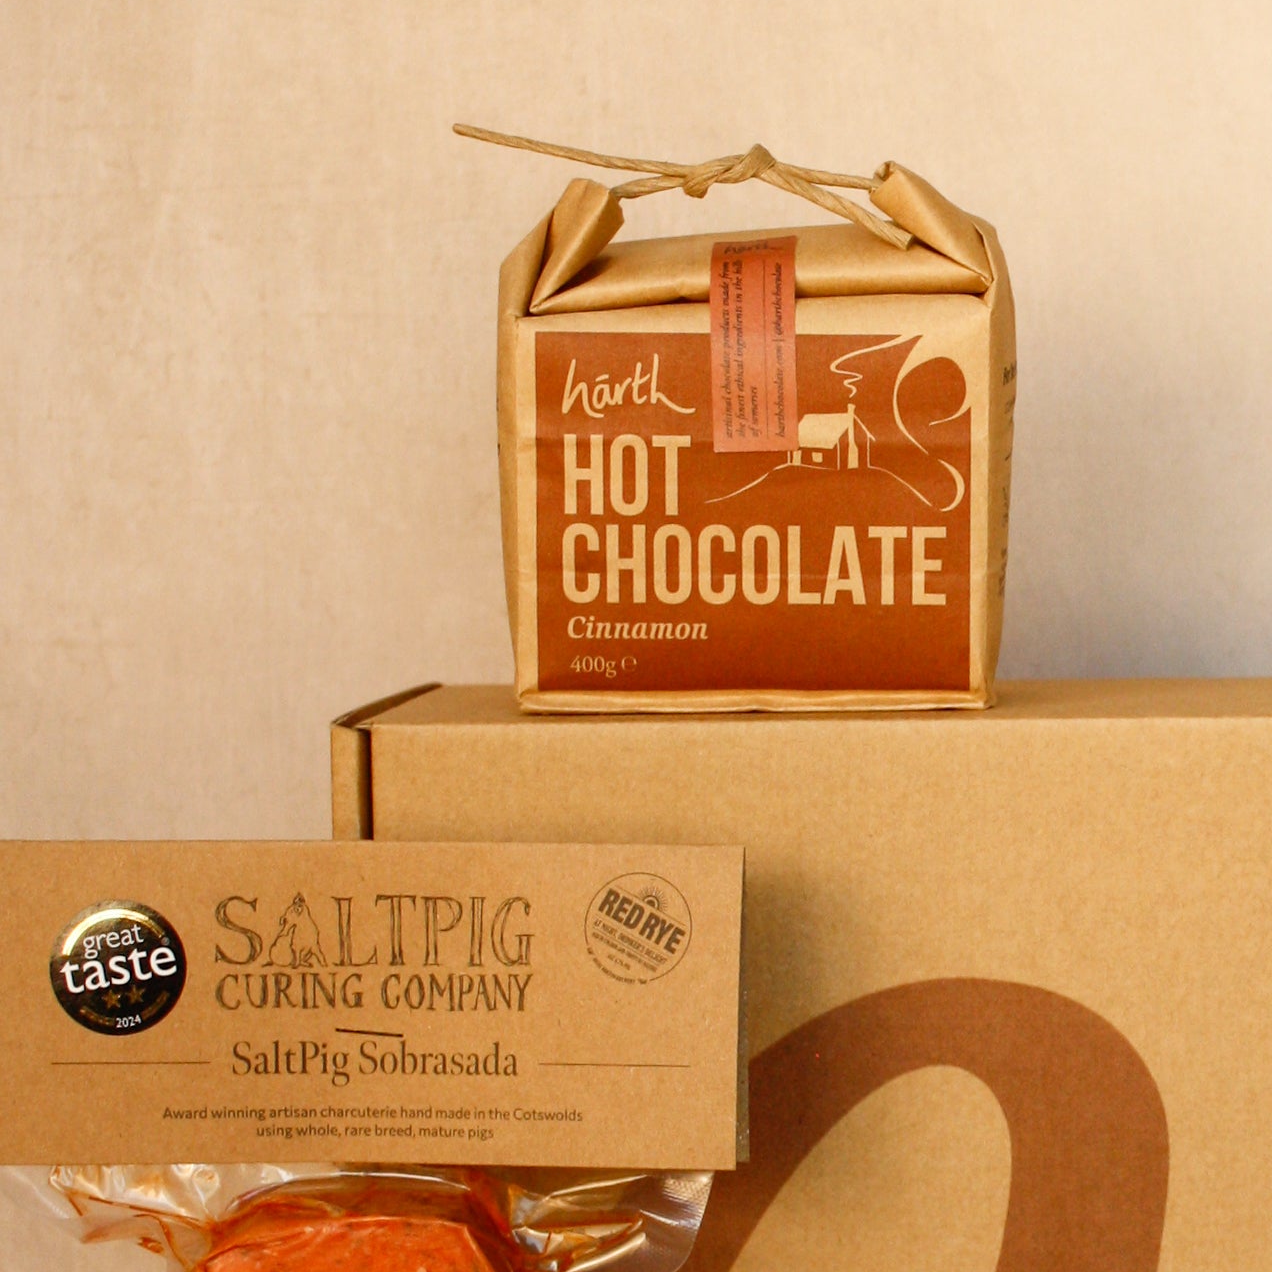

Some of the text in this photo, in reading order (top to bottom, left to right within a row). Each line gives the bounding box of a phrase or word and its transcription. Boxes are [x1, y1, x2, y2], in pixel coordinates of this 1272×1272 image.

[719, 261, 732, 280] from
[733, 275, 743, 291] the
[719, 281, 729, 306] made
[735, 293, 743, 303] in
[733, 305, 746, 358] ingredients
[733, 359, 744, 393] ethical
[563, 433, 692, 516] HOT
[562, 523, 947, 606] CHOCOLATE
[567, 615, 708, 640] Cinnamon
[570, 655, 617, 678] 400g
[214, 891, 535, 970] SALTPIG
[598, 888, 645, 930] RED
[639, 912, 686, 955] RYE
[83, 924, 144, 959] great
[60, 946, 177, 994] taste
[214, 972, 534, 1012] CURING COMPANY
[115, 1014, 141, 1028] 2024
[232, 1040, 519, 1086] SaltPig Sobrasada
[163, 1105, 584, 1122] Award winning artisan charcuterie hand made in the Cotswolds
[256, 1123, 494, 1141] using whole, rare breed, mature pigs
